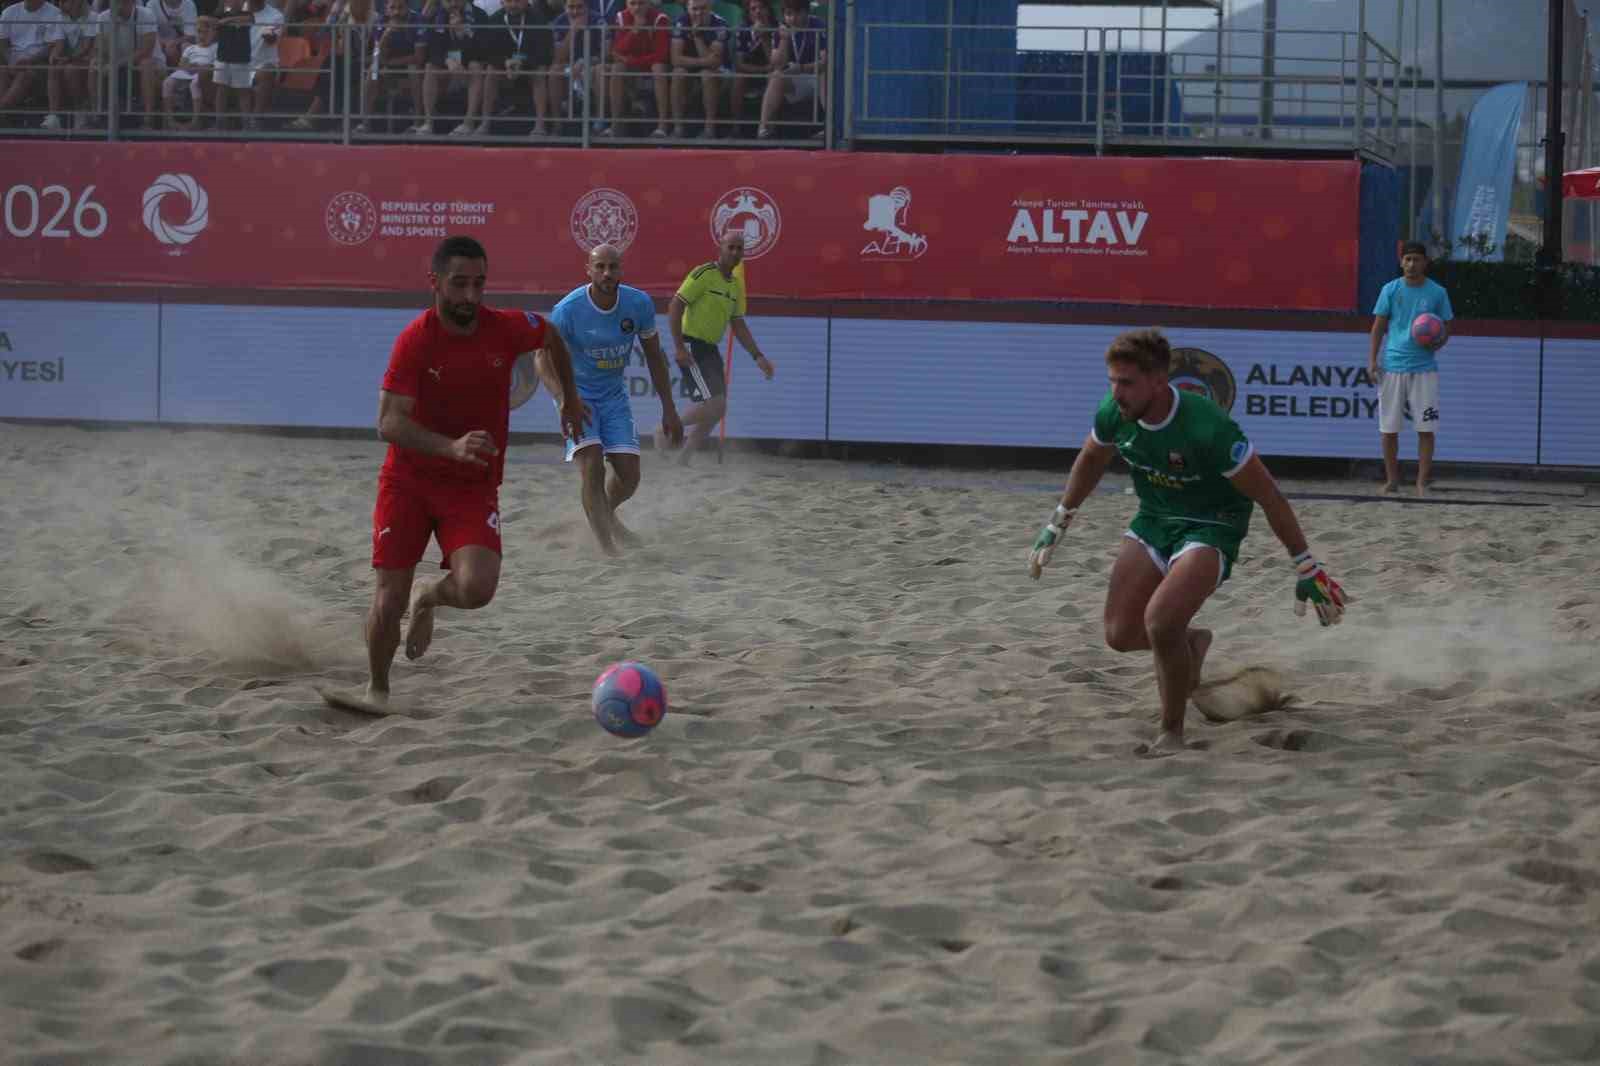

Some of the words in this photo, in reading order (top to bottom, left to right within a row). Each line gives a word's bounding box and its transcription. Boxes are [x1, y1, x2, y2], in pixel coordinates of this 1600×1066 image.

[0, 184, 108, 238] 026
[381, 201, 431, 213] REPUBLIC
[432, 202, 448, 213] OF
[381, 214, 431, 225] MINISTRY
[432, 214, 447, 225] OF
[449, 214, 486, 225] YOUTH
[381, 226, 404, 236] AND
[405, 226, 448, 237] SPORTS
[1007, 208, 1149, 245] ALTAV
[1245, 363, 1375, 388] ALANYA
[1246, 392, 1414, 420] BELEDİY
